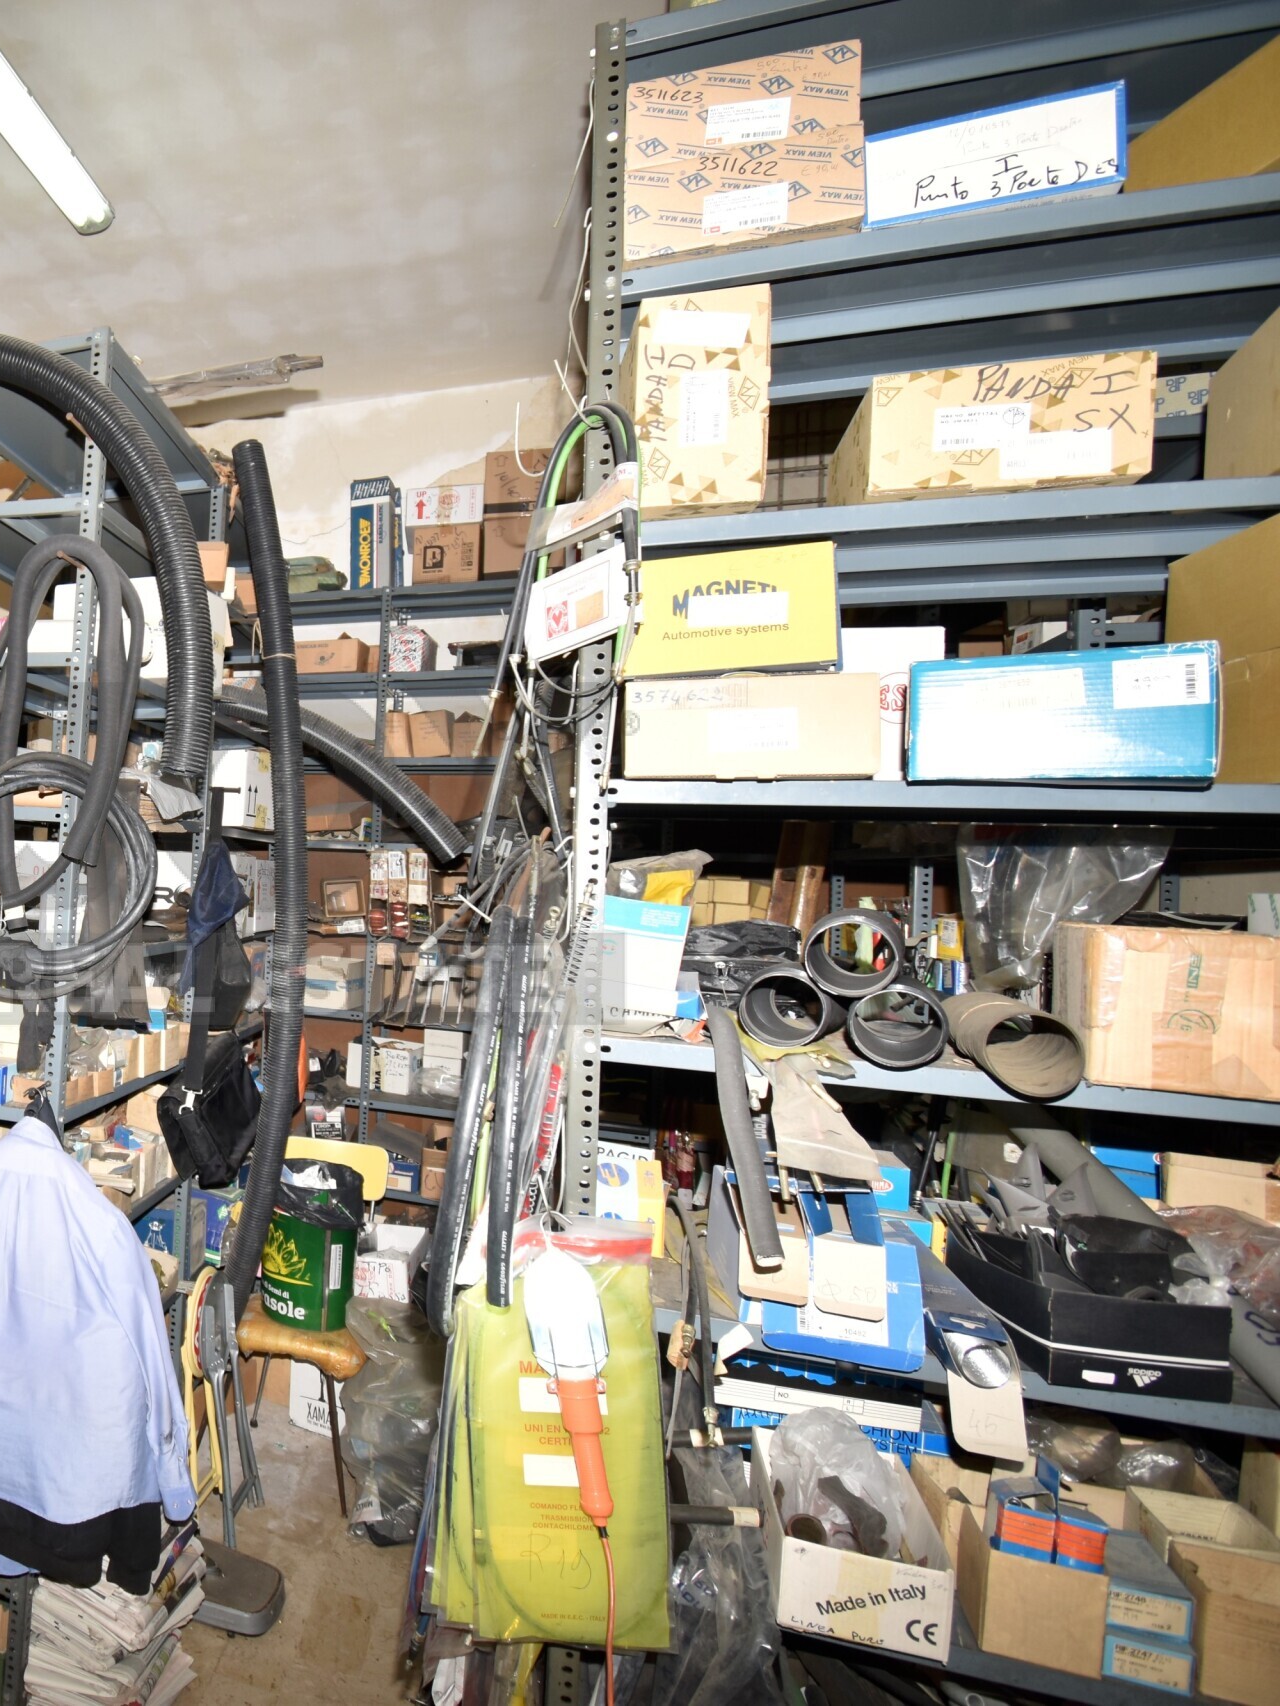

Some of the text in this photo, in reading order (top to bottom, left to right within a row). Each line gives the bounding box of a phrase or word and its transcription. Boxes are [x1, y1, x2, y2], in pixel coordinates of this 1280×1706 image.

[707, 75, 751, 86] VIEW MAX
[634, 86, 704, 103] 3511623
[803, 85, 849, 97] VIEW MAX
[646, 106, 688, 117] VIEW MAX
[785, 148, 832, 159] VIEW MAX
[696, 156, 778, 177] 3511622
[627, 174, 670, 184] VIEW MAX
[820, 190, 844, 199] MAX
[990, 180, 1002, 198] 3
[658, 214, 679, 222] MAX
[972, 364, 1074, 403] PANDA
[416, 491, 427, 499] UP
[359, 526, 371, 579] MONROE
[662, 623, 790, 641] Automotive systems
[1127, 1367, 1162, 1378] adidas
[524, 1424, 562, 1435] UNI EN
[530, 1502, 568, 1512] COMANDO
[816, 1584, 927, 1616] Made in Italy
